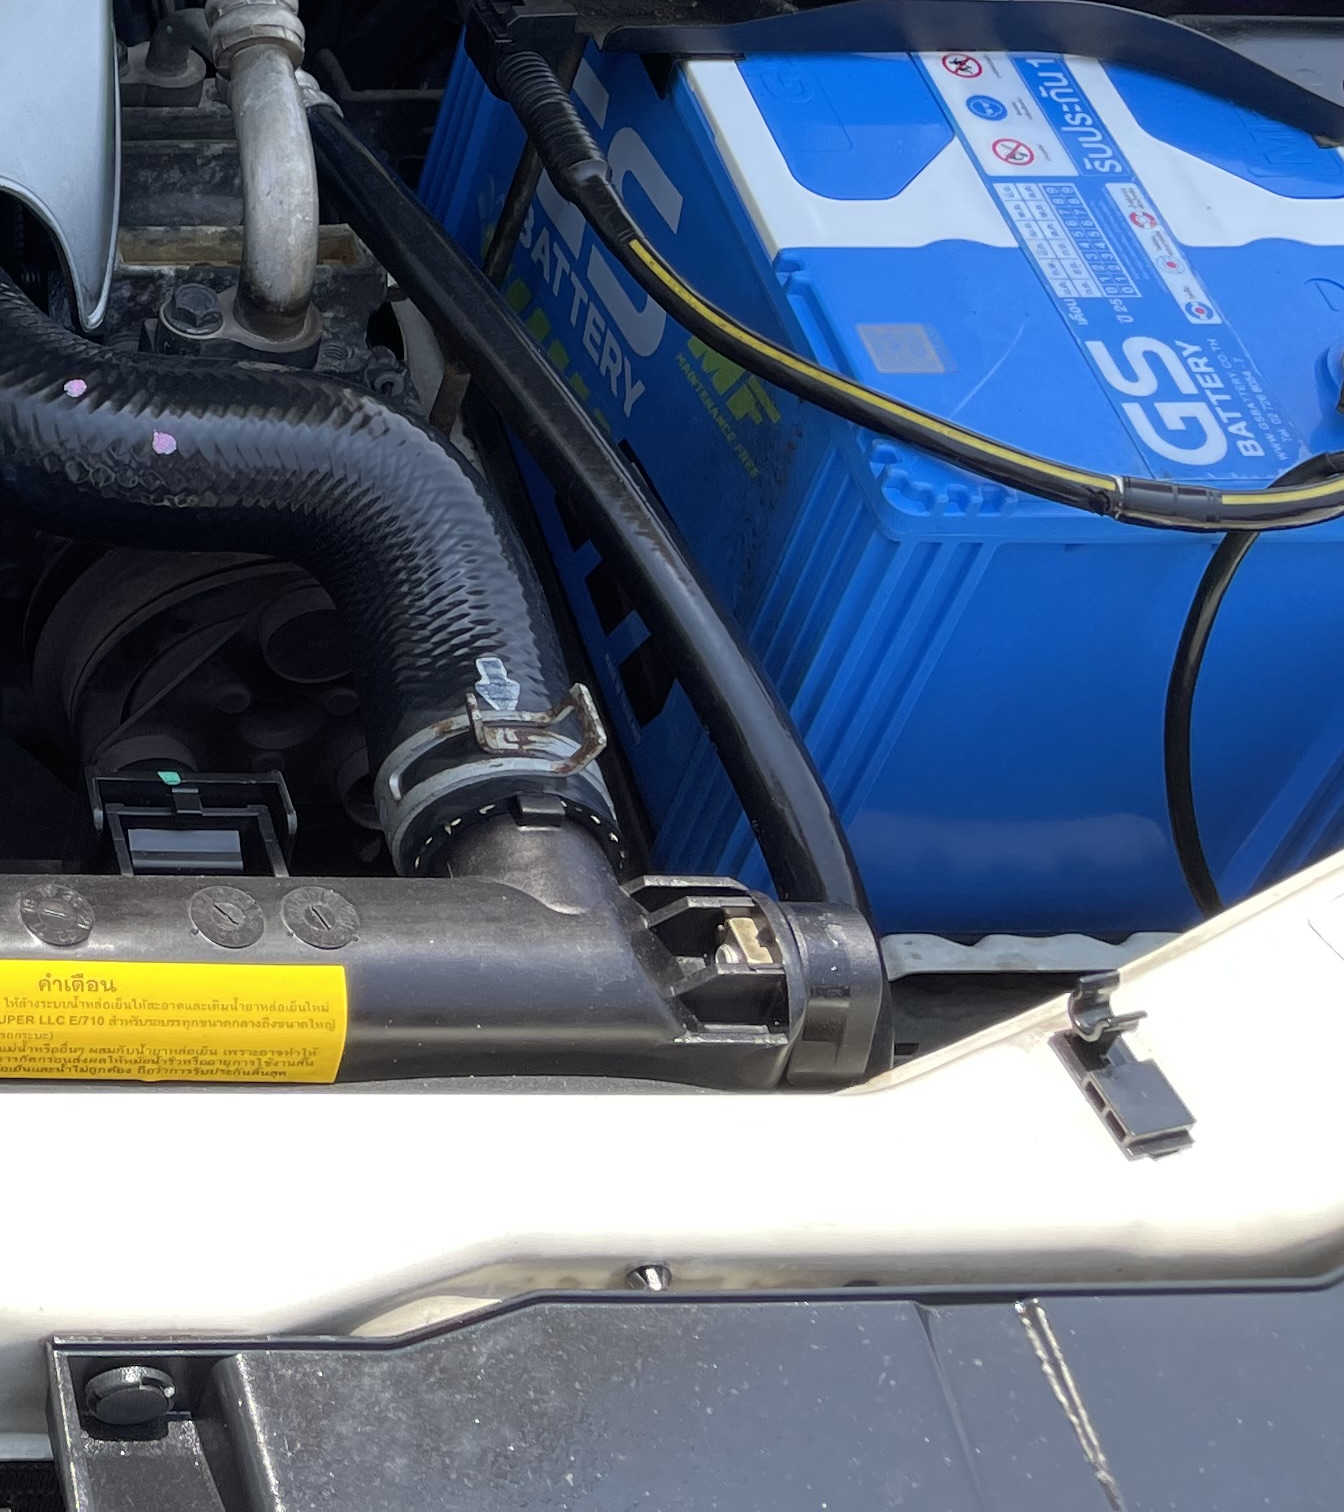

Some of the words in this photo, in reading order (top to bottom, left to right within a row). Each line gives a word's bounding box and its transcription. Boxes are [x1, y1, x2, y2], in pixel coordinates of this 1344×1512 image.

[1041, 73, 1123, 173] รับประกัน
[1085, 336, 1228, 466] GS
[1174, 340, 1265, 456] BATTERY
[38, 972, 117, 993] คำเตือน
[39, 1014, 65, 1025] LLC
[70, 1015, 105, 1026] E/710
